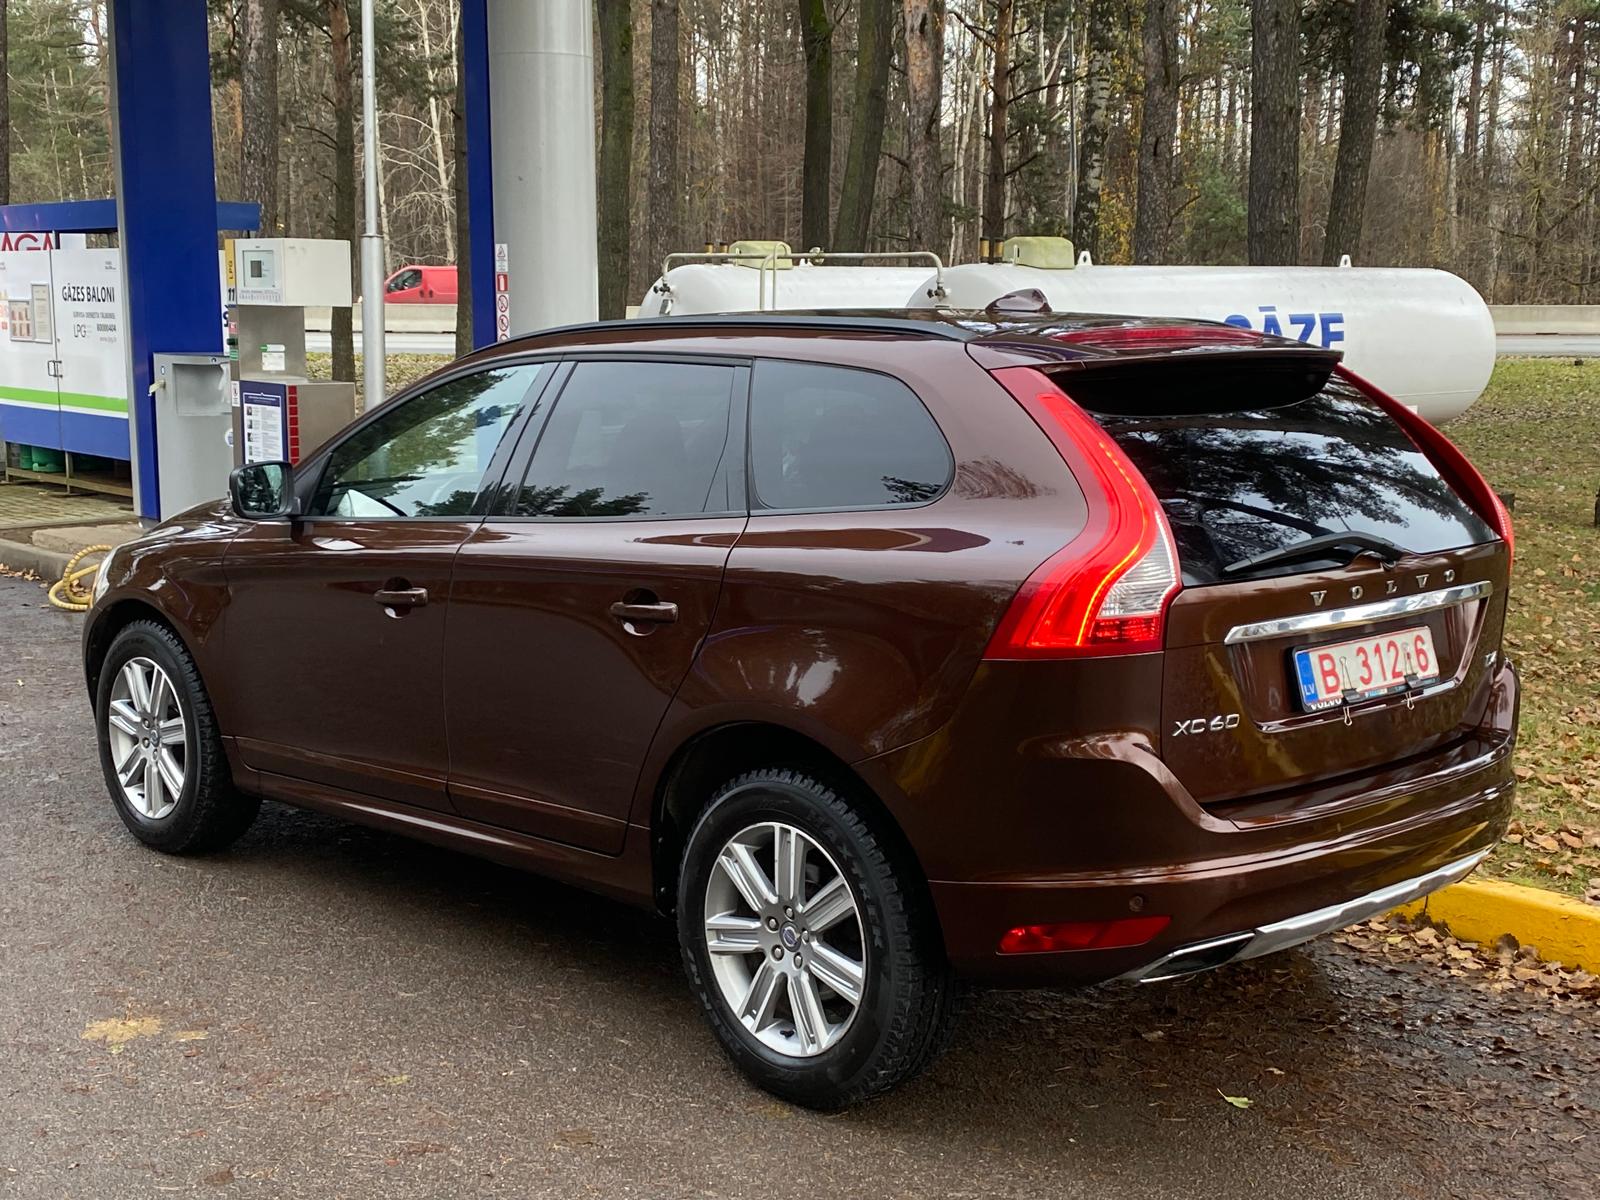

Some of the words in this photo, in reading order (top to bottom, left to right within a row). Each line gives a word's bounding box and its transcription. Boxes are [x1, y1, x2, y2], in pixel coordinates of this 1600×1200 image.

[86, 286, 115, 303] BALONI
[228, 288, 235, 302] 11
[73, 323, 87, 338] LPG
[1310, 569, 1455, 606] VOLVO
[1318, 653, 1341, 694] B
[1304, 683, 1314, 696] LV
[1310, 698, 1342, 710] VOLVO
